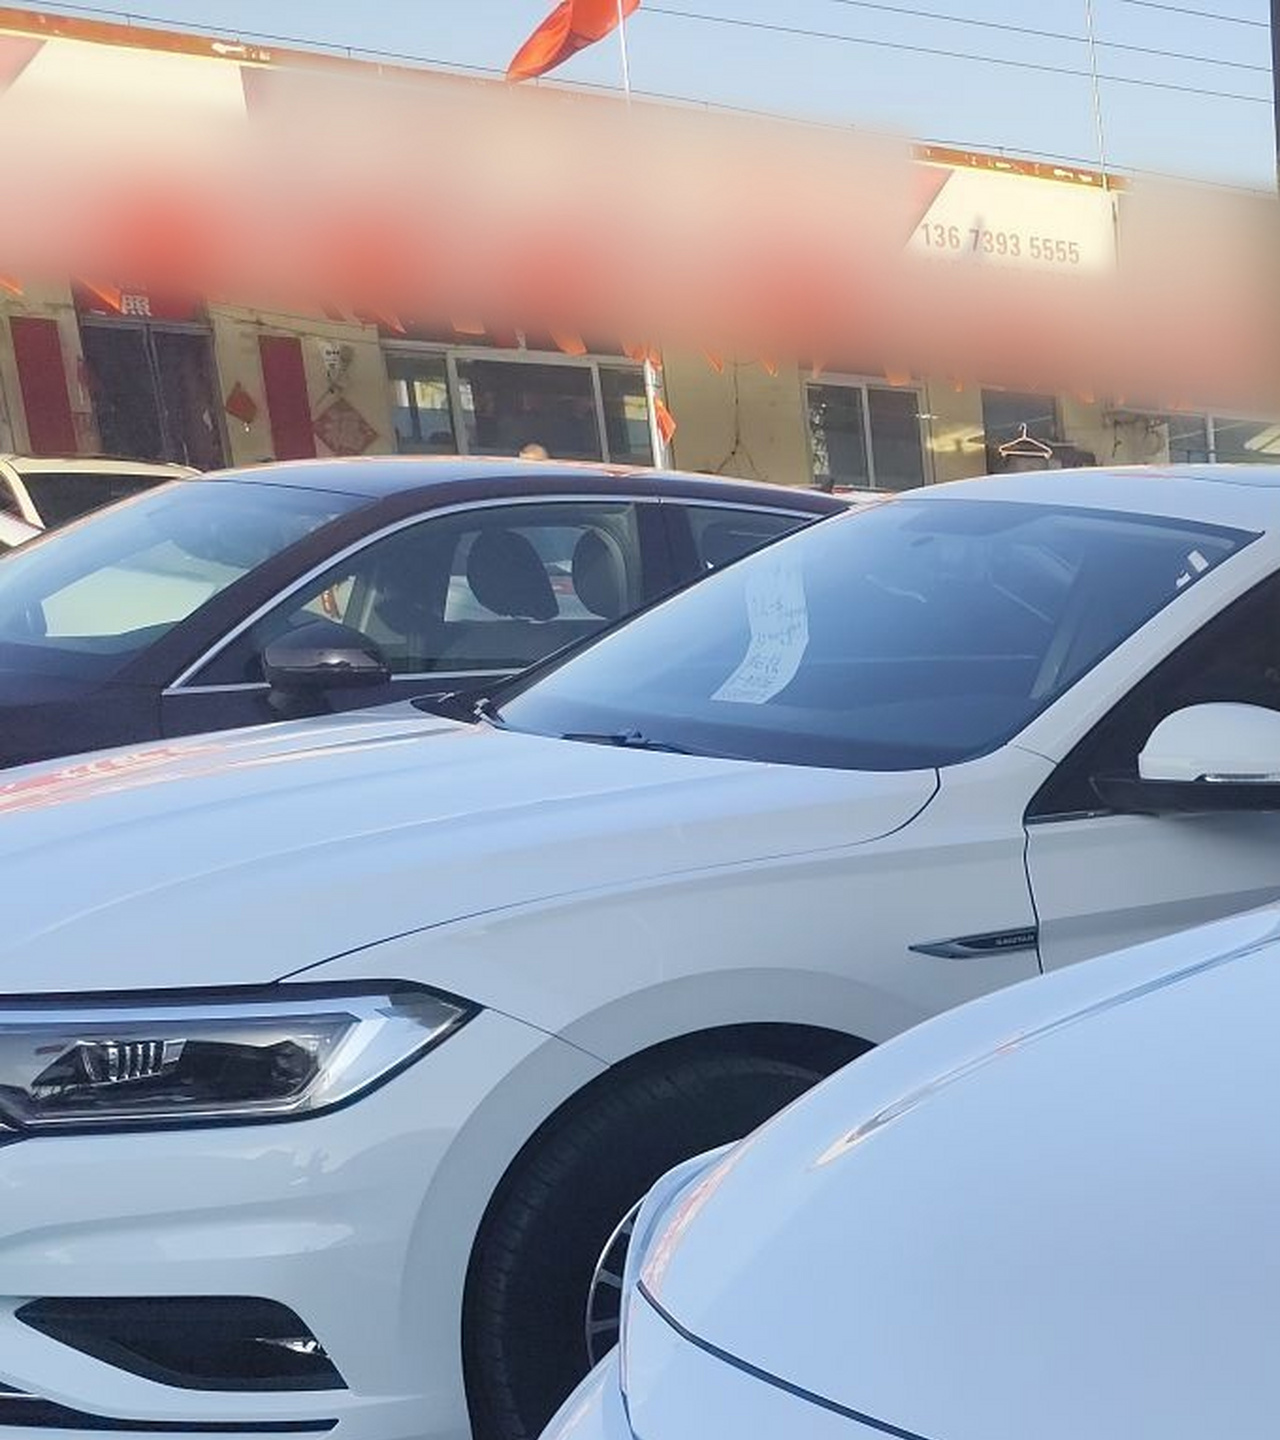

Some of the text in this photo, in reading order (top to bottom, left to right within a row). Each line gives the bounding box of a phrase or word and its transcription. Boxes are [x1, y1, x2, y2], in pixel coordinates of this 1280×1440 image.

[921, 222, 1081, 265] 136 7393 5555
